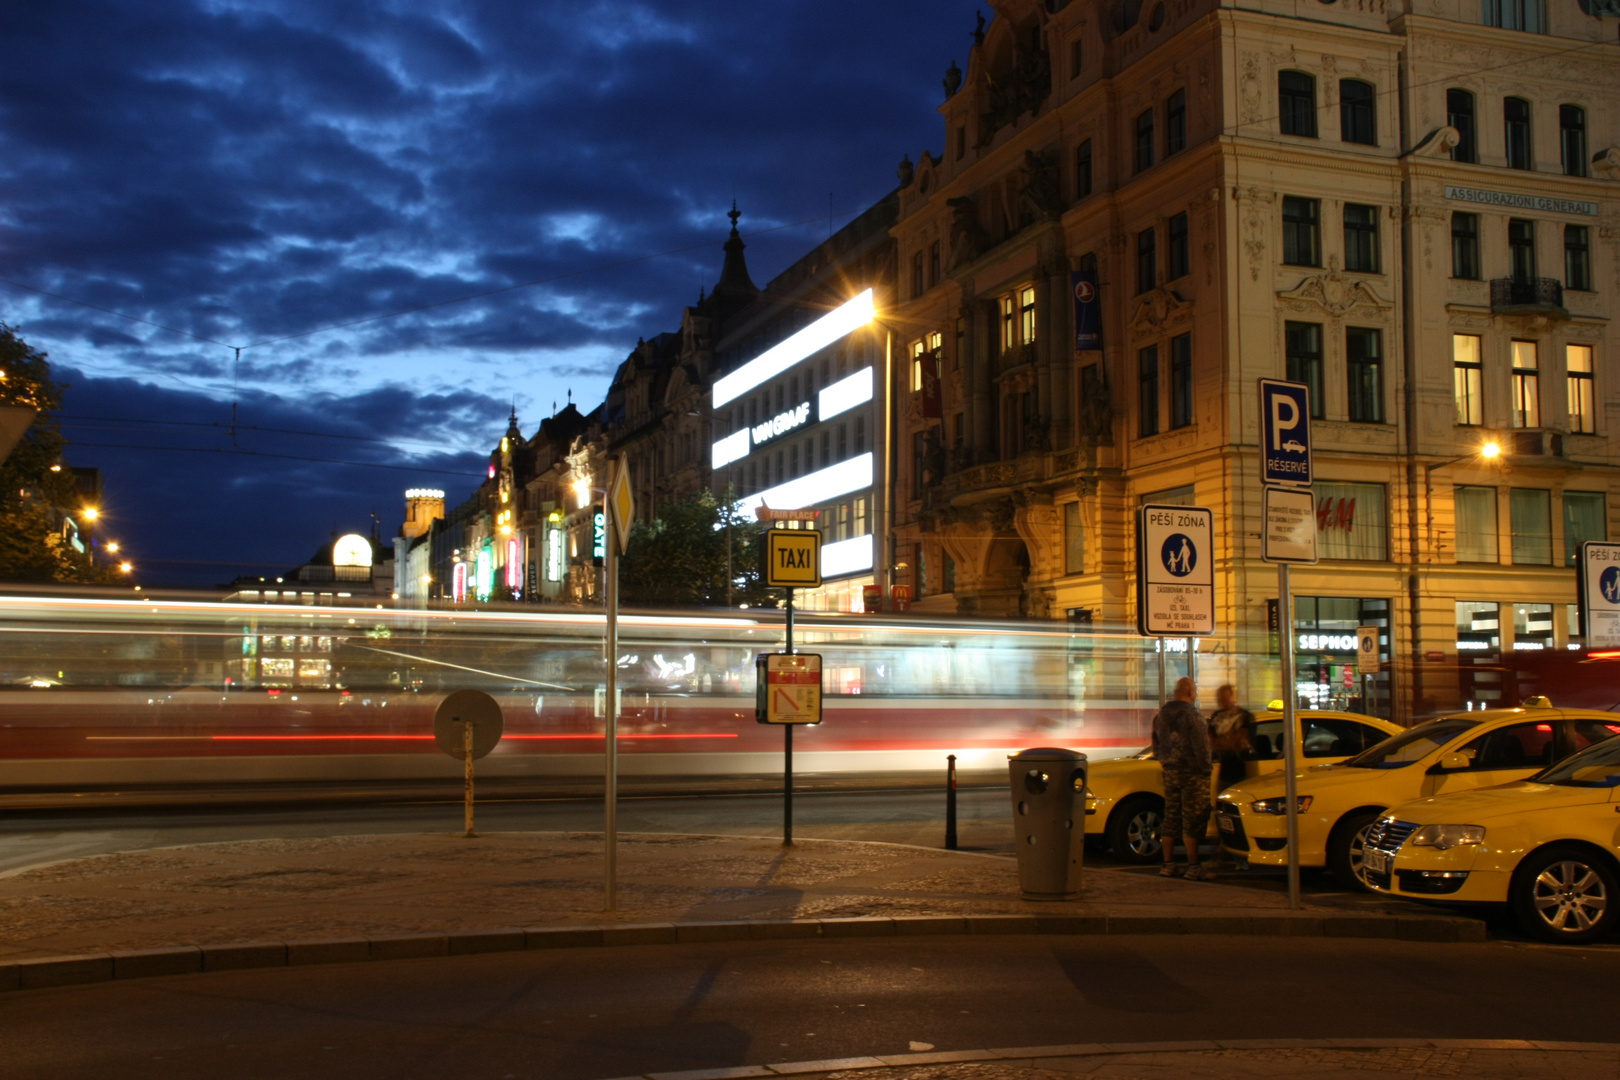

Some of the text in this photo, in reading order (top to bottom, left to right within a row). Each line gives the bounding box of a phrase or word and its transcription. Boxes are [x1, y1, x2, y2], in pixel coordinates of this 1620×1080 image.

[1450, 188, 1591, 214] ASSICURAZIONI GENERALI
[752, 402, 809, 443] VAN GRAAF
[1271, 393, 1300, 451] P
[1268, 456, 1308, 474] RÉSERVÉ
[769, 510, 815, 520] FAIR PLACE
[1150, 512, 1206, 528] PĚŠÍ ZÓNA
[1316, 496, 1356, 532] H&M
[594, 513, 605, 558] GATE
[777, 548, 810, 568] TAXI
[1590, 549, 1609, 561] PĚŠÍ
[1299, 635, 1358, 650] SEPHO
